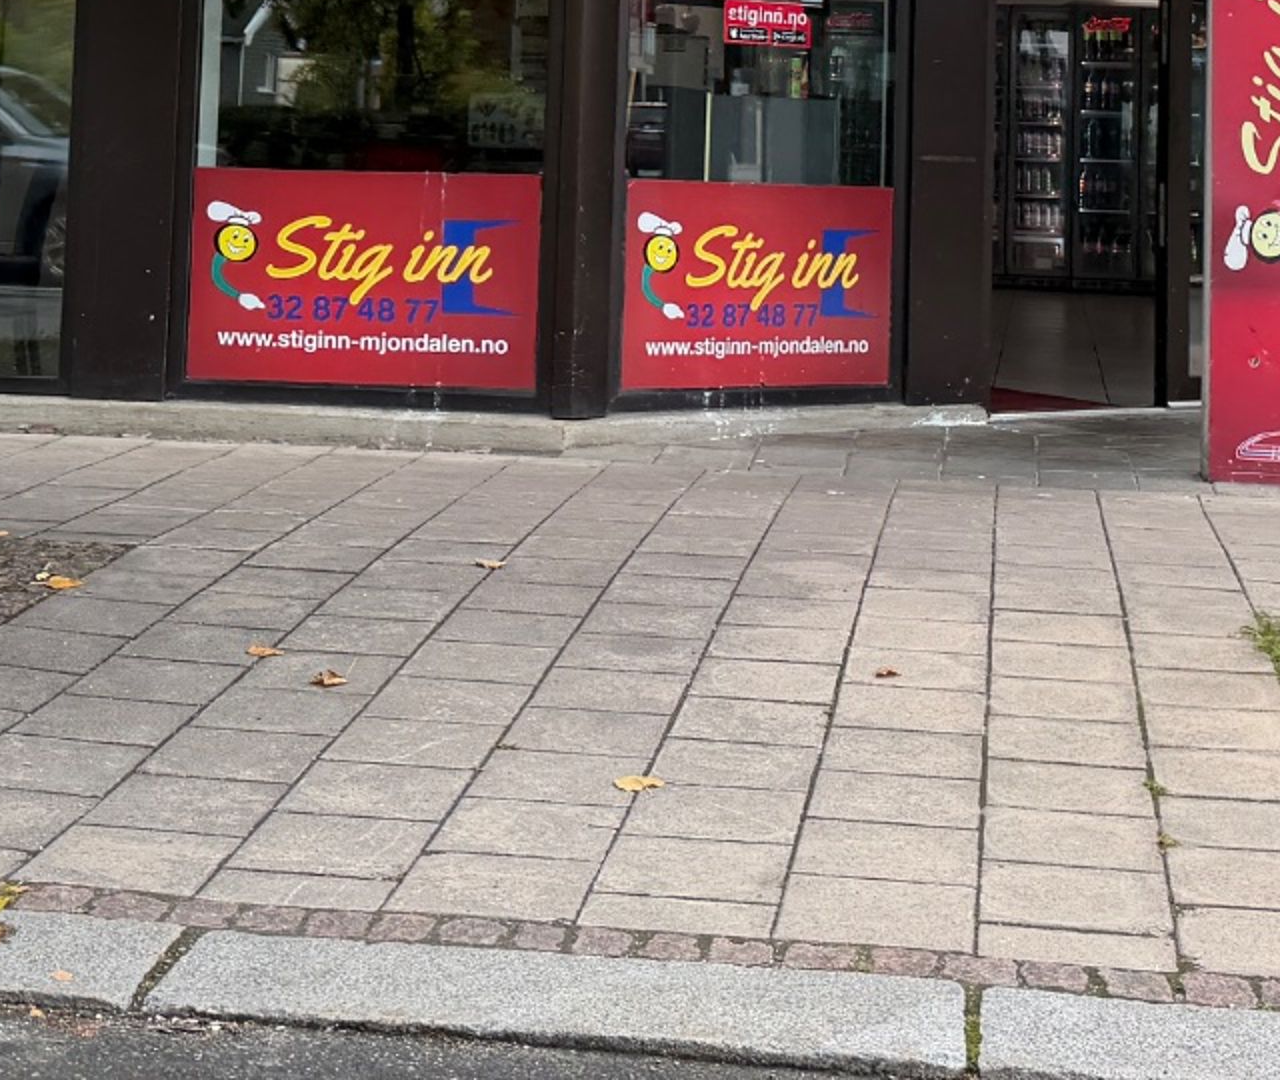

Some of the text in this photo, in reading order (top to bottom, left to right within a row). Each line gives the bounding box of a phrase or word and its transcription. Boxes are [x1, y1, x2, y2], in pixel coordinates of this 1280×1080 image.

[265, 215, 494, 306] Stig inn
[685, 225, 860, 311] Stig inn
[267, 294, 439, 324] 32 87 48 77
[686, 303, 818, 328] 32 87 48 77
[217, 328, 509, 355] www.stiginn-mjondalen.no
[645, 336, 868, 359] www.stiginn-mjondalen.no
